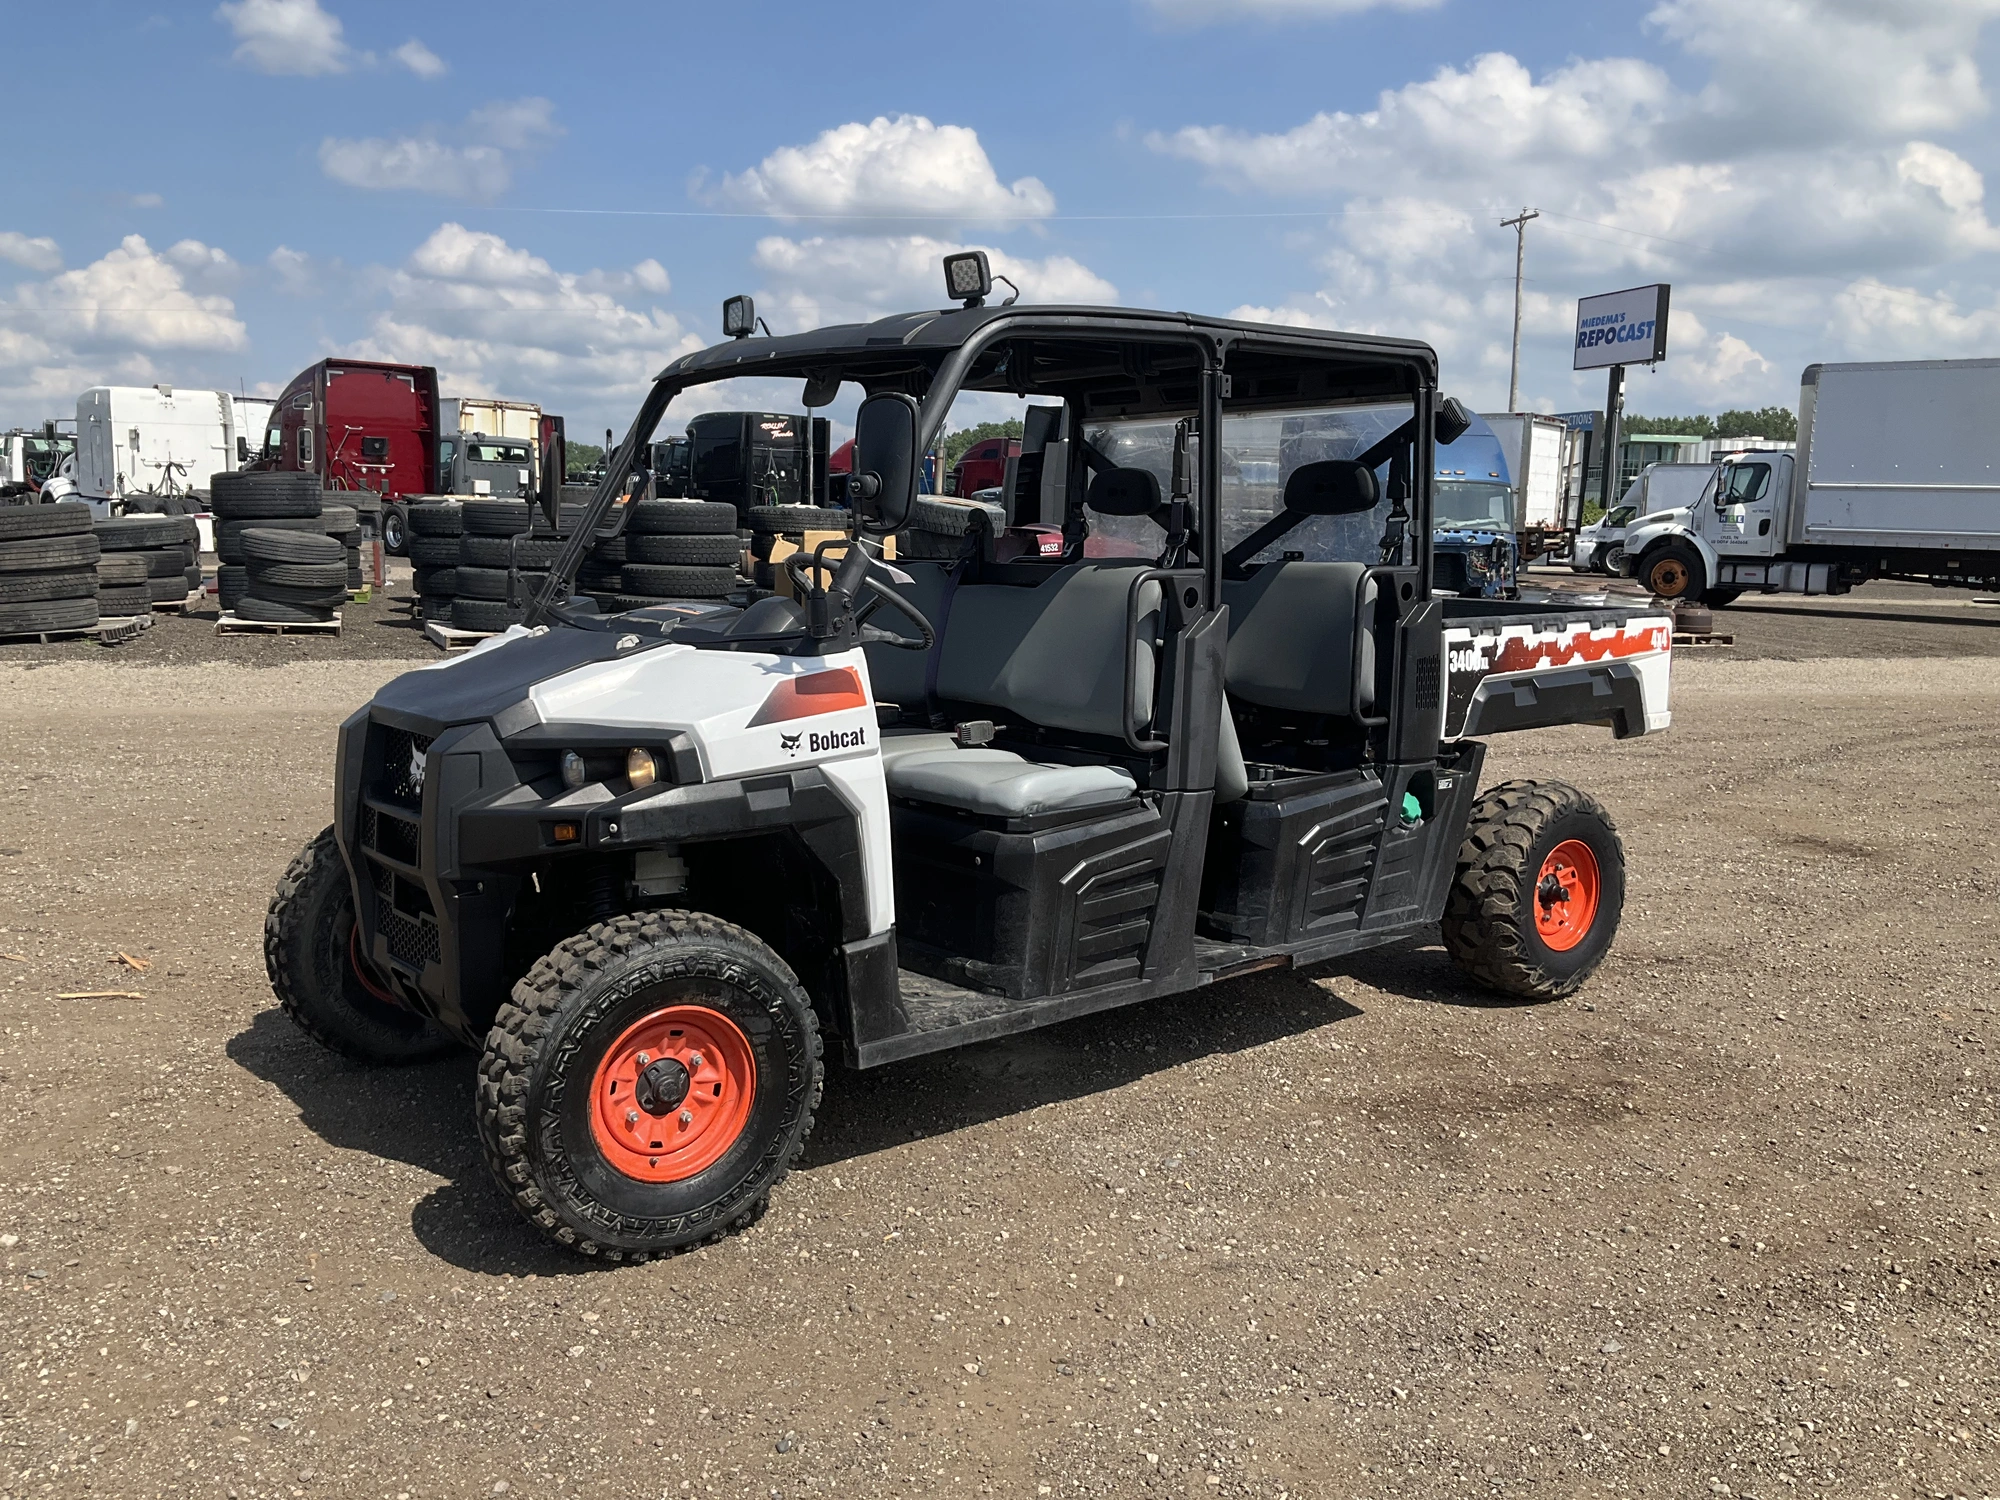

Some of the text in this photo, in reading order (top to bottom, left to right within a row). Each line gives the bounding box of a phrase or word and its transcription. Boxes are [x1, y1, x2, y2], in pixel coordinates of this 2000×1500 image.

[1580, 312, 1626, 329] MIEDEMA'S
[1577, 320, 1655, 349] REPOCAST
[1040, 542, 1059, 553] 41532
[809, 726, 866, 752] Bobcat
